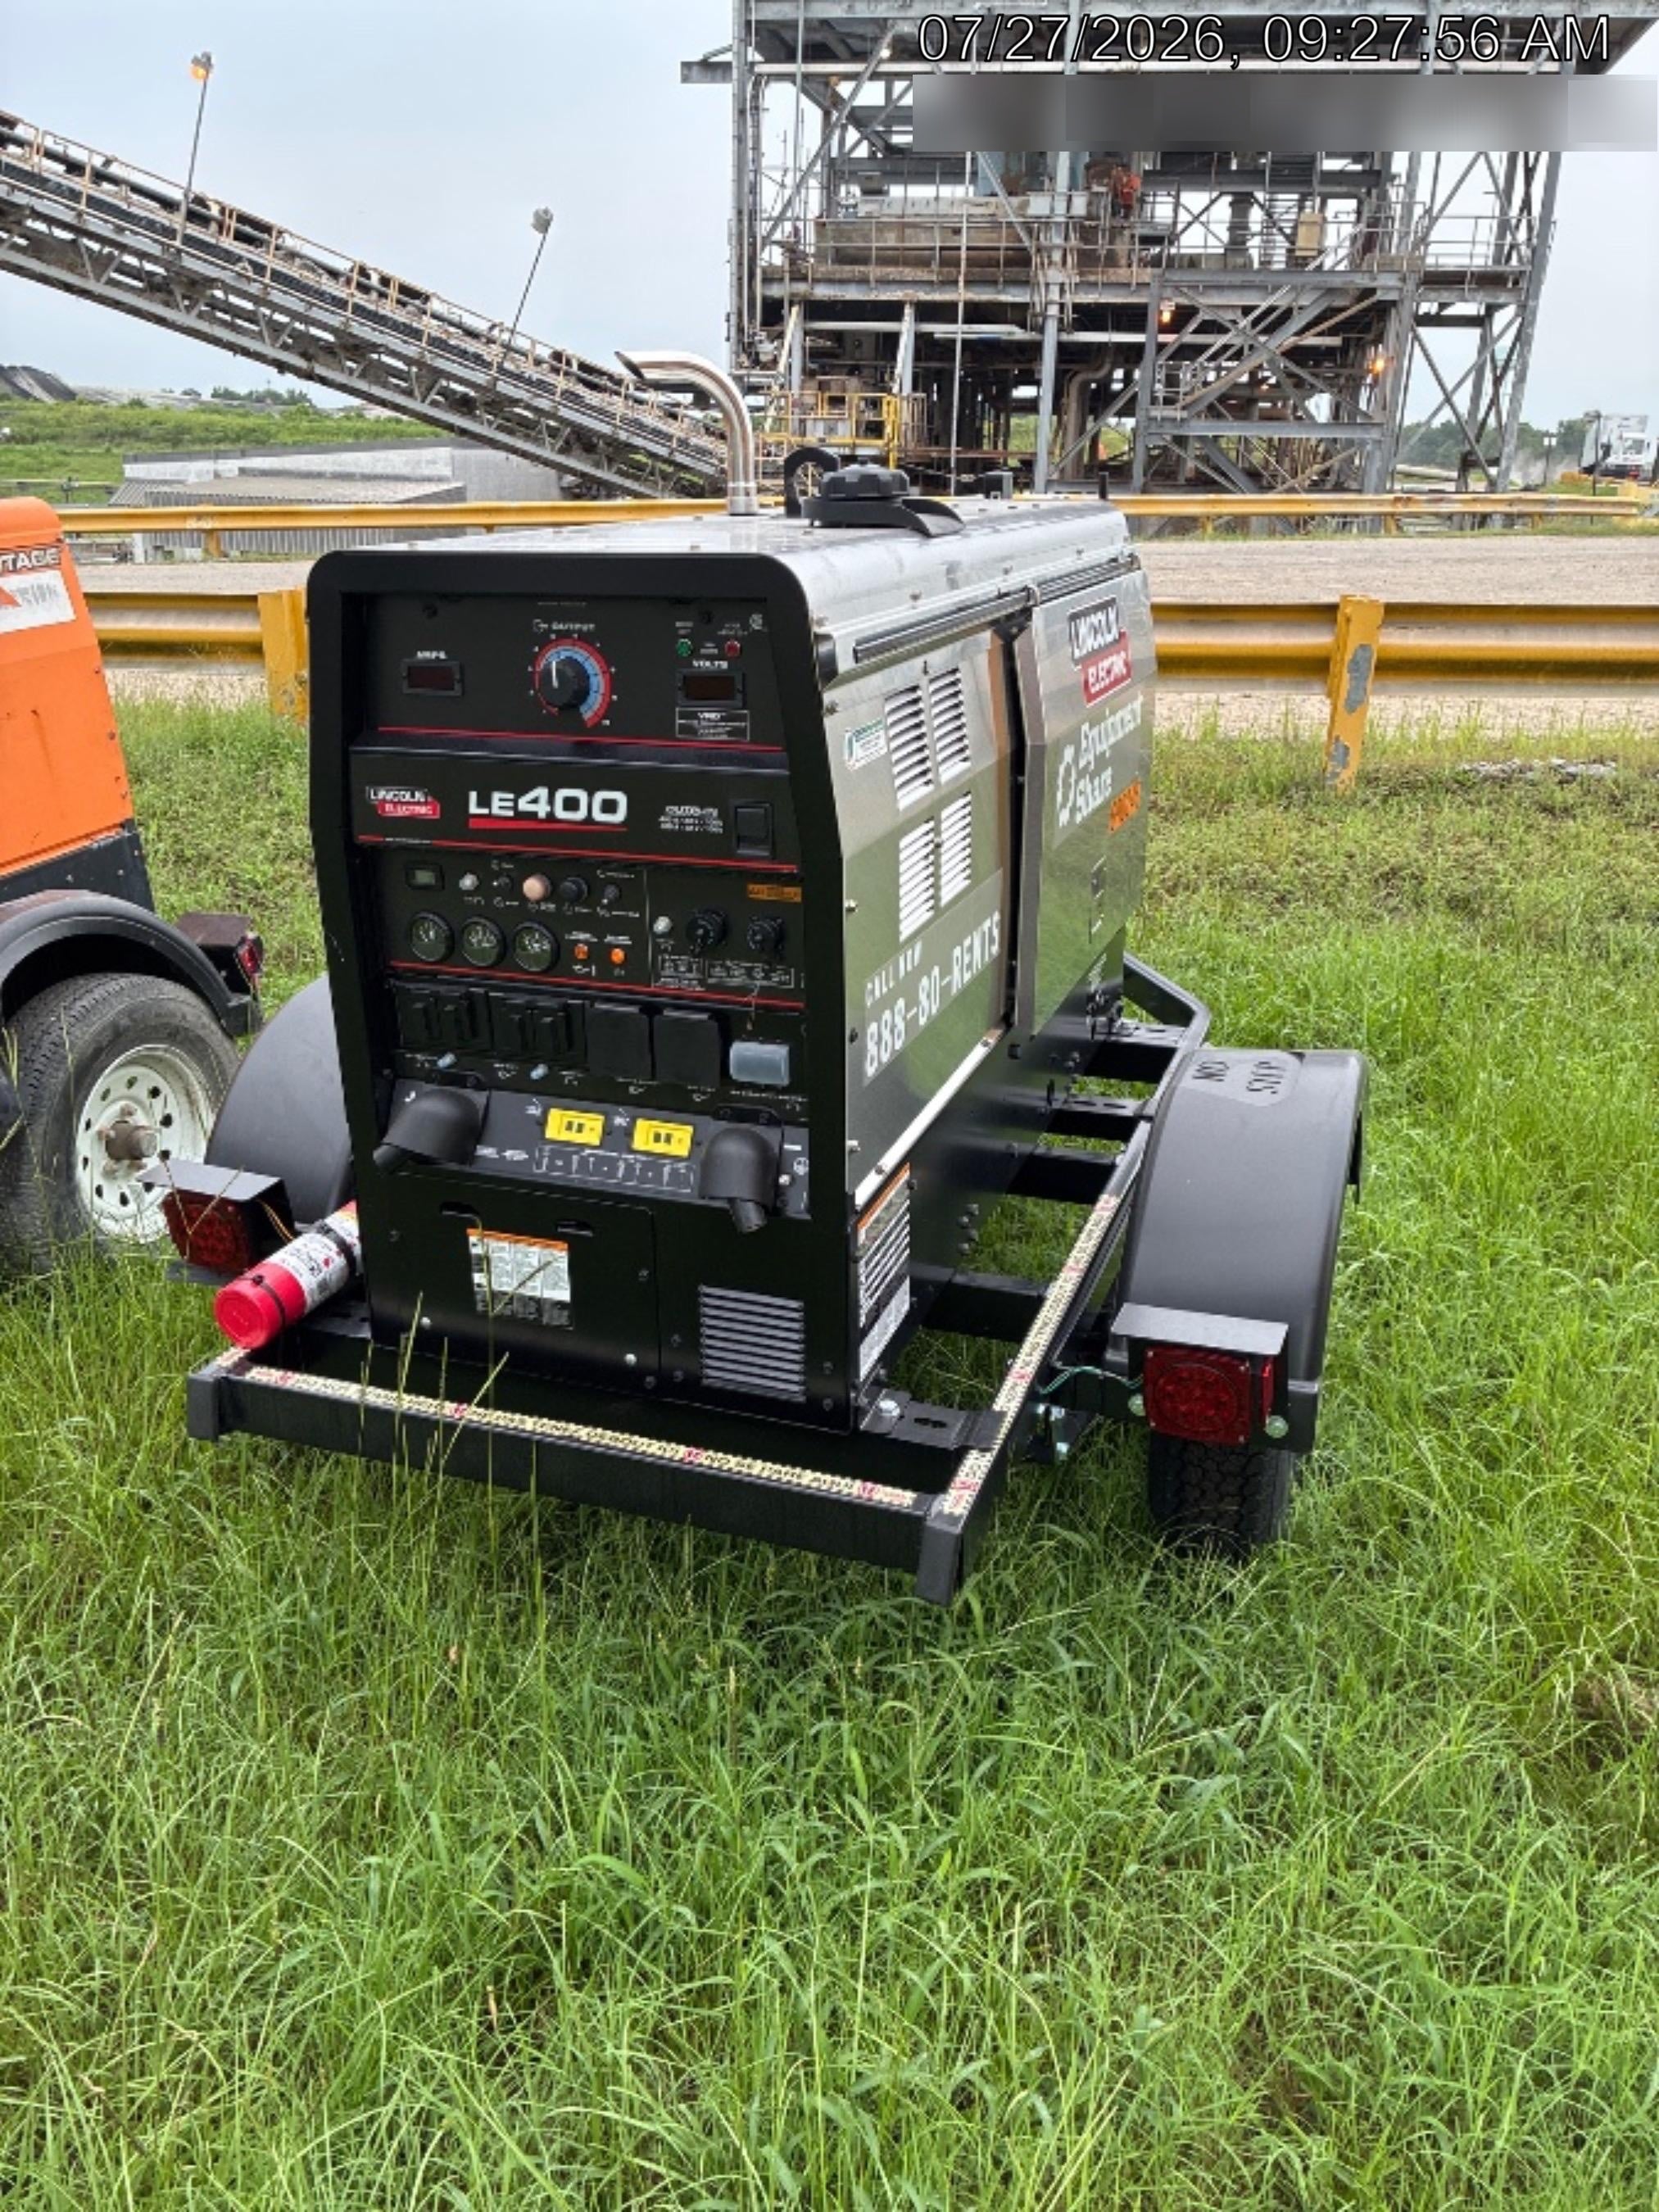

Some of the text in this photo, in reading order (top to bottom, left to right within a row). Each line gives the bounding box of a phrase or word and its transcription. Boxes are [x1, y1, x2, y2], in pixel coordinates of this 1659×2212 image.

[0, 547, 60, 573] TAGE
[1070, 605, 1119, 660] LINCOLN
[1087, 651, 1127, 695] ELECTRIC
[369, 788, 426, 802] LINCOLN
[384, 803, 433, 815] ELECTRIC
[468, 786, 628, 824] LE400
[1076, 766, 1113, 824] Share
[865, 909, 1002, 1077] 888-80-RENTS
